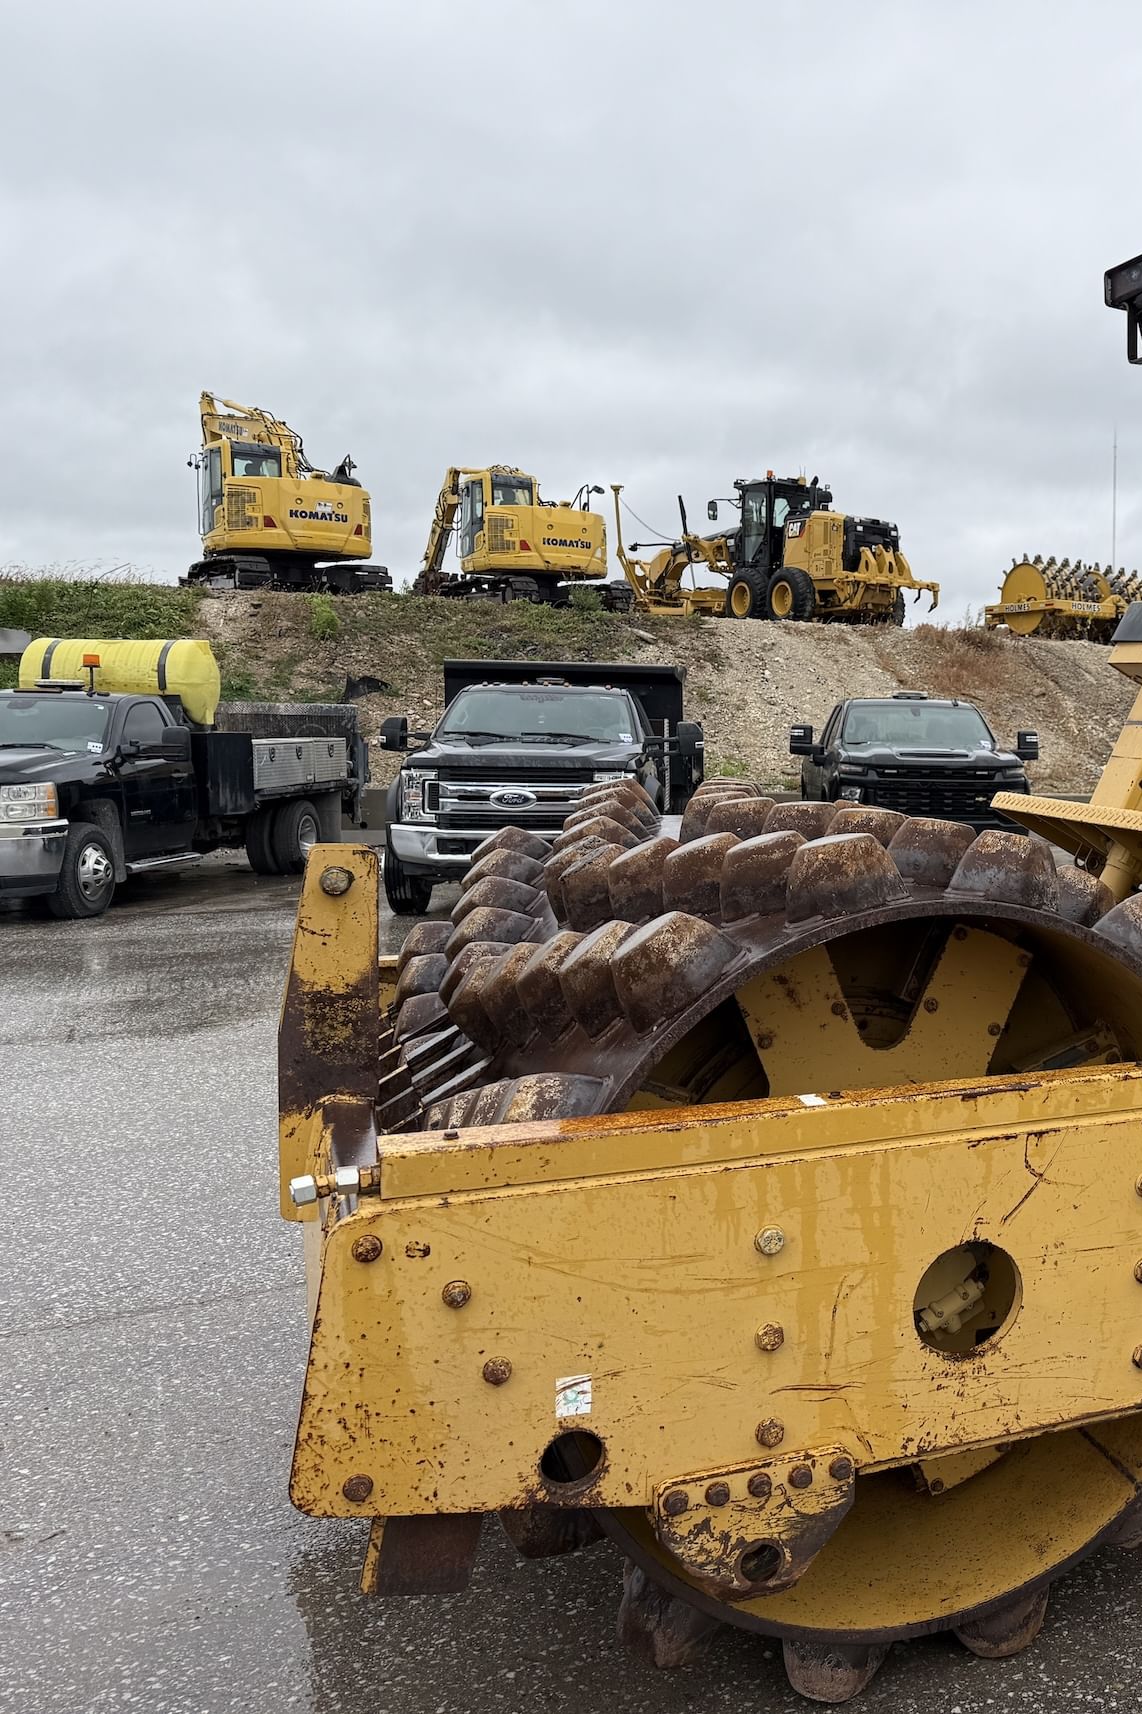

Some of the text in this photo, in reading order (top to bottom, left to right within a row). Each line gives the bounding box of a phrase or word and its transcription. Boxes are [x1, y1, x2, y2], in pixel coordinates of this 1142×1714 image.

[289, 509, 348, 523] KOMATSU
[788, 522, 801, 537] CAT
[542, 537, 592, 549] KOMATSU
[1005, 603, 1031, 612] HOLMES
[1071, 602, 1101, 612] HOLMES
[502, 793, 525, 804] Ford
